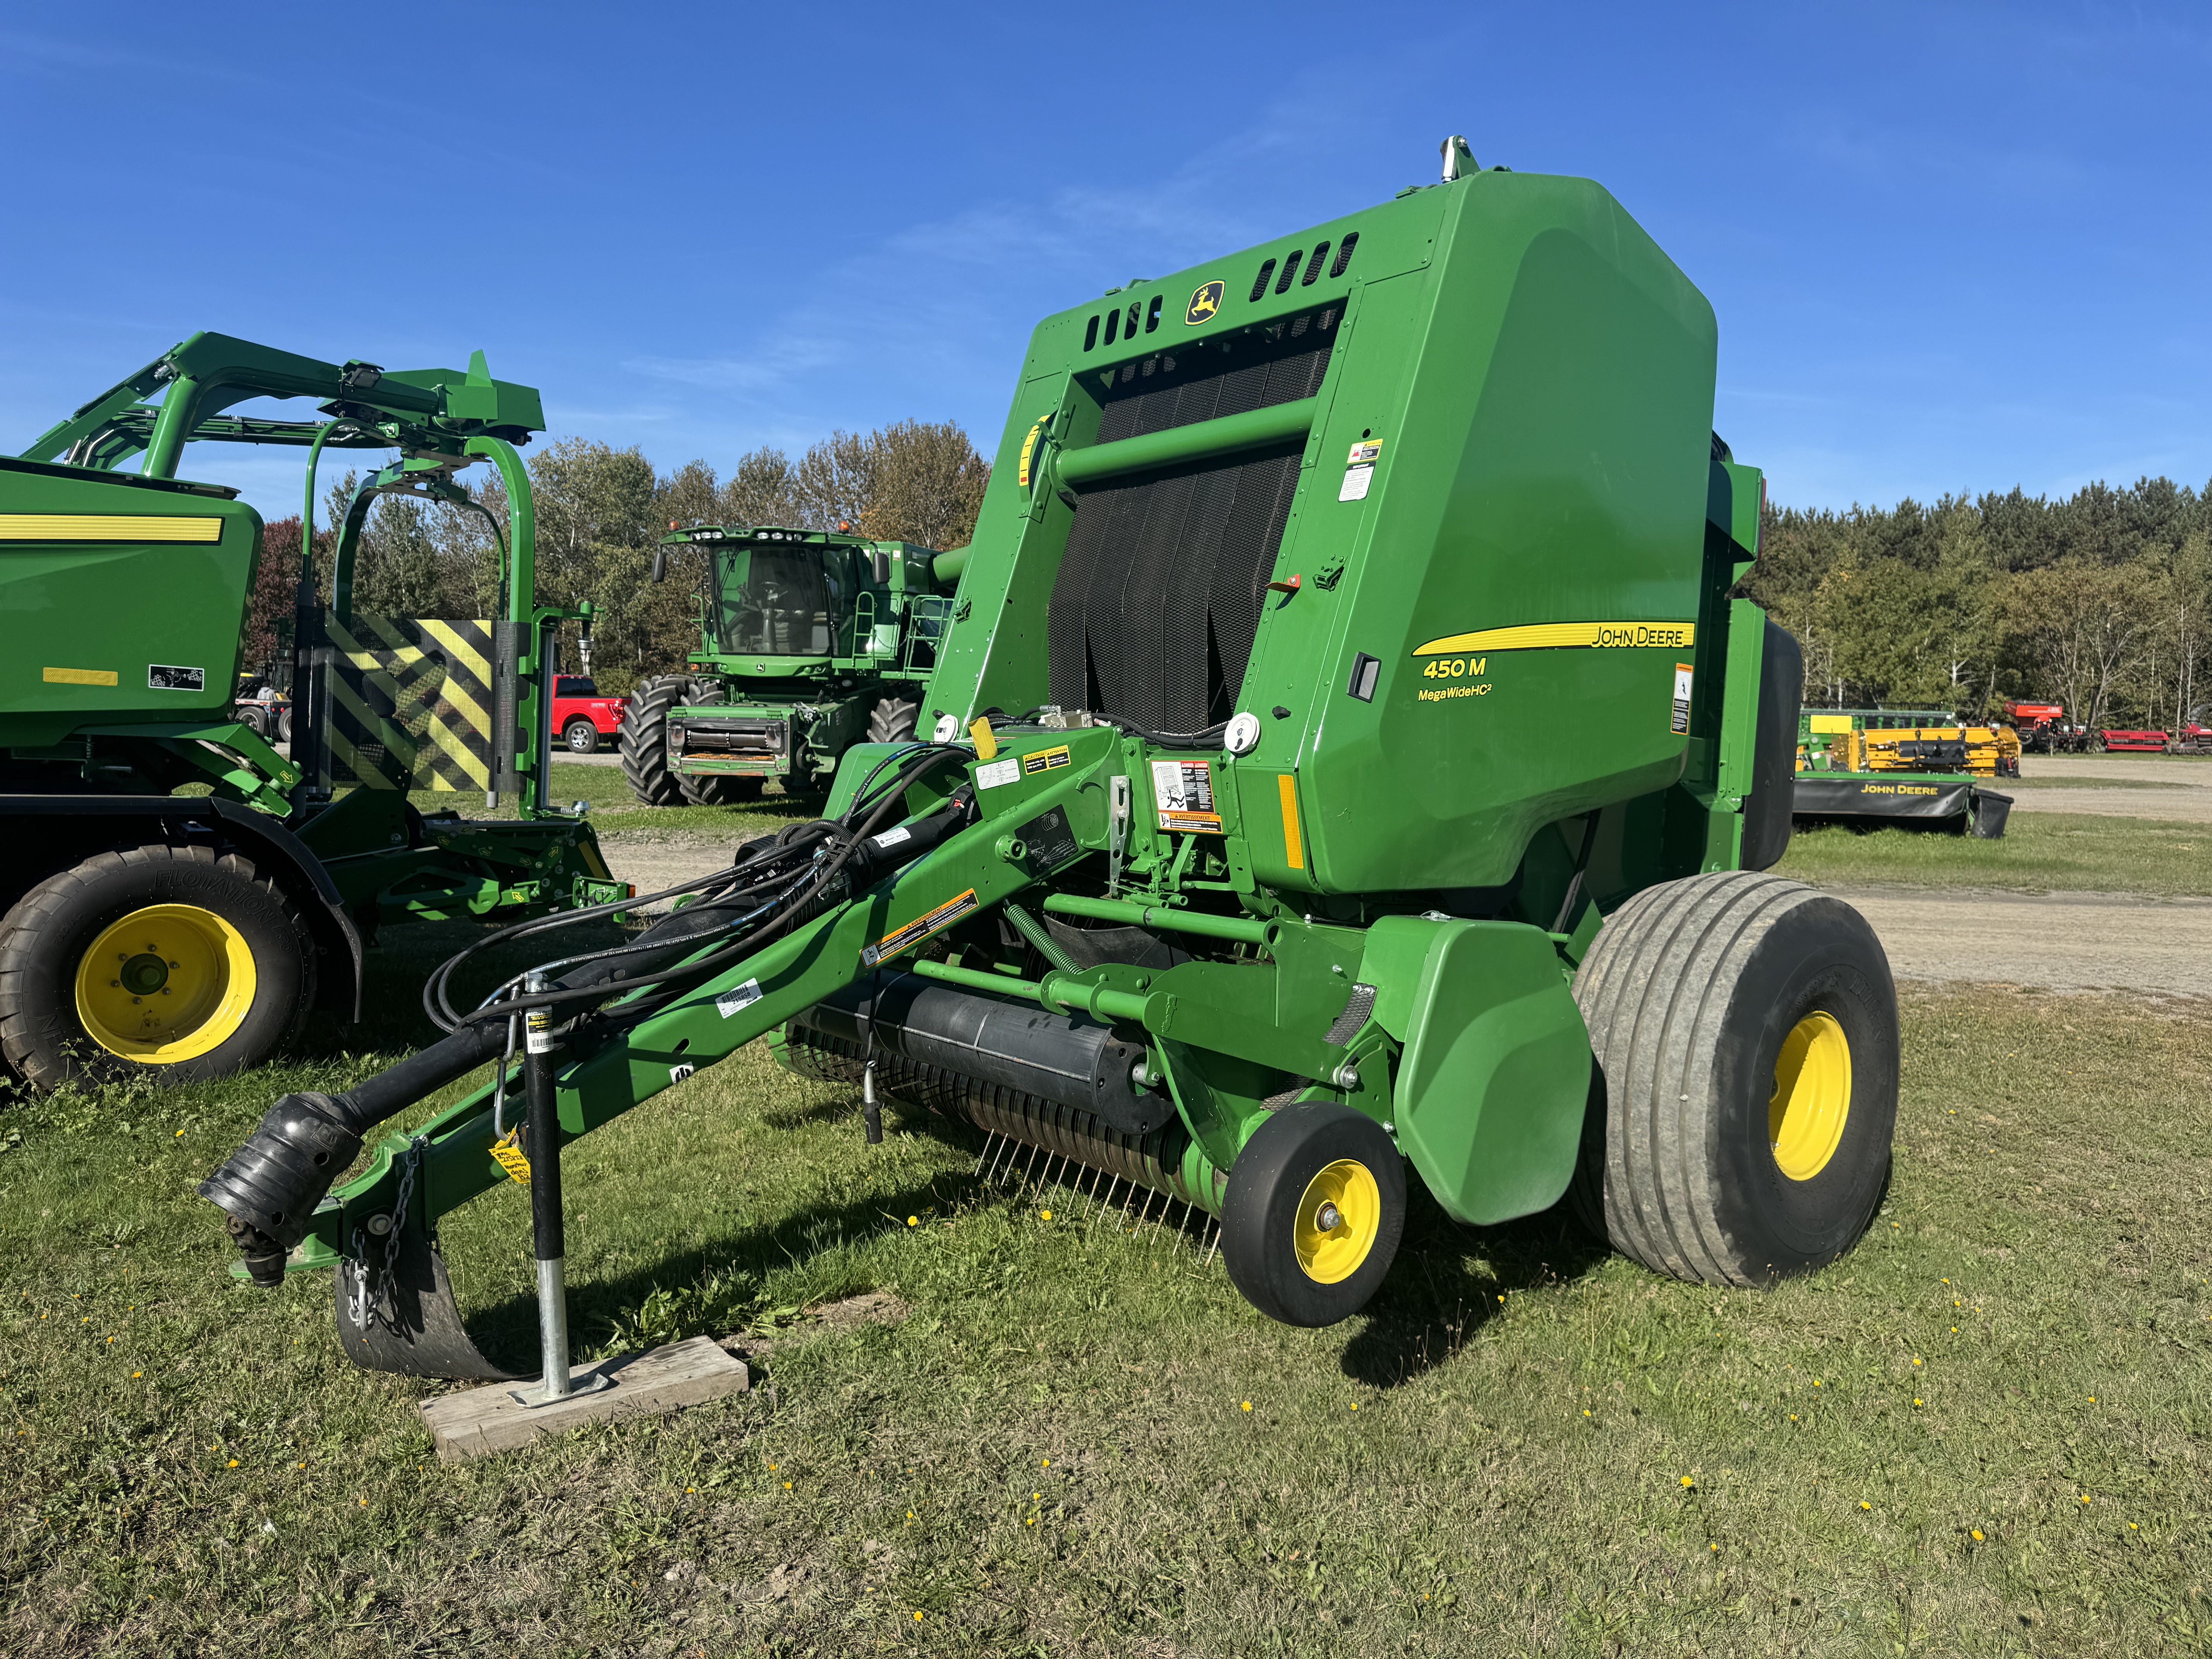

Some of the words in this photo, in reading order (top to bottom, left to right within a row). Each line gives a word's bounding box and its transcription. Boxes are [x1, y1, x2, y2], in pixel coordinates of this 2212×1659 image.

[1592, 626, 1633, 644] JOHN
[1637, 627, 1683, 644] DEERE
[1424, 659, 1465, 678] 450
[1468, 658, 1486, 676] M
[1861, 784, 1895, 794] JOHN
[1898, 785, 1938, 795] DEERE
[155, 869, 278, 925] FLOTATION
[272, 924, 292, 953] PRO
[912, 906, 942, 926] AVERTISSEMENT
[732, 991, 751, 1005] 215858
[1849, 972, 1887, 1044] TITAN
